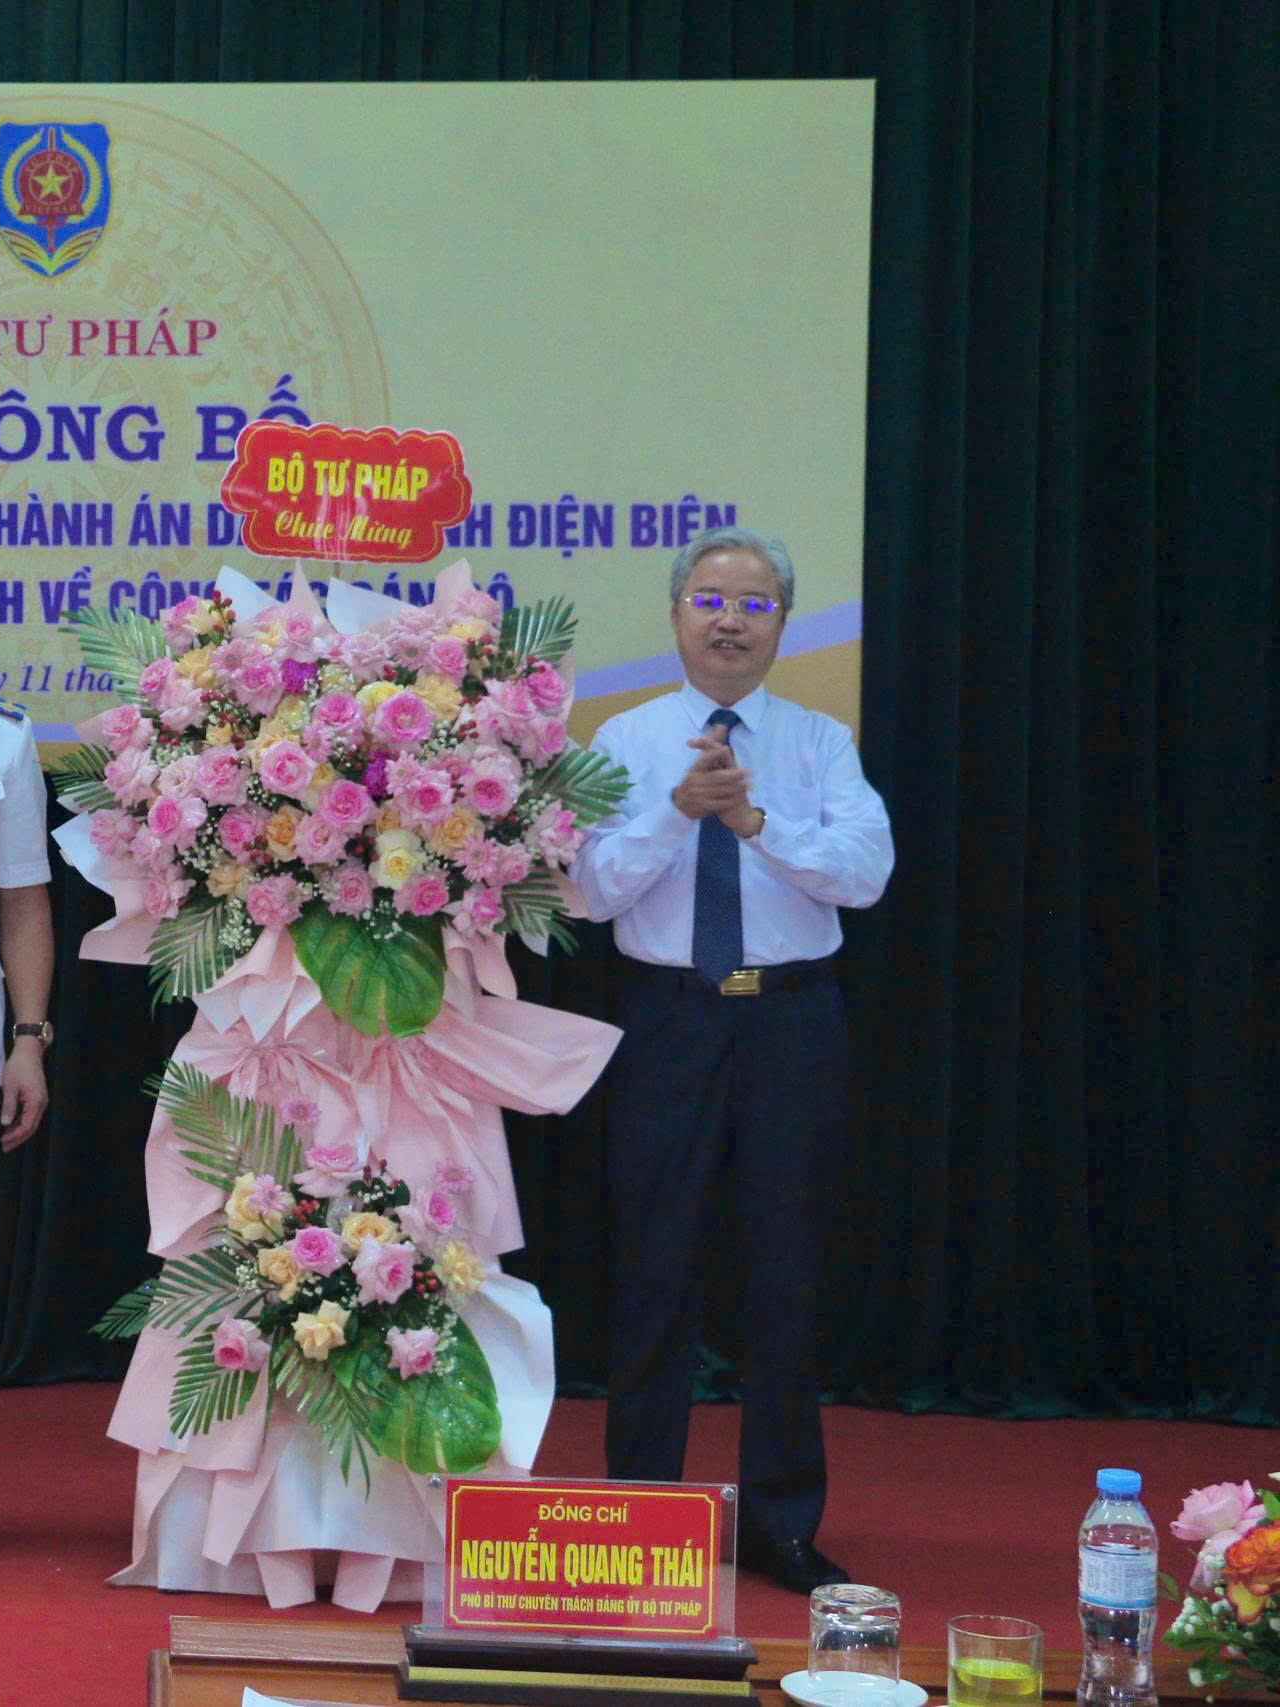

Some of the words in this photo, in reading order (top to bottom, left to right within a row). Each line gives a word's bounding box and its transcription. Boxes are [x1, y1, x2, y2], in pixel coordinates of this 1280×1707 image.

[67, 307, 218, 357] PHÁP
[267, 451, 305, 502] BỘ
[313, 458, 350, 497] TƯ
[354, 457, 429, 501] PHÁP
[127, 494, 191, 547] ÁN
[508, 494, 614, 558] ĐIỆN
[631, 494, 737, 547] BIÊN
[21, 665, 52, 692] 11
[538, 1498, 592, 1521] ĐỒNG
[596, 1502, 627, 1523] CHÍ
[461, 1527, 556, 1582] NGUYỄN
[564, 1543, 643, 1587] QUANG
[650, 1539, 703, 1587] THÁI
[460, 1592, 481, 1607] PHÓ
[496, 1593, 517, 1608] THƯ
[519, 1594, 558, 1610] CHUYÊN
[561, 1595, 593, 1612] TRÁCH
[596, 1595, 624, 1613] ĐẢNG
[642, 1598, 657, 1617] BỘ
[659, 1600, 672, 1615] TƯ
[674, 1599, 702, 1617] PHÁP
